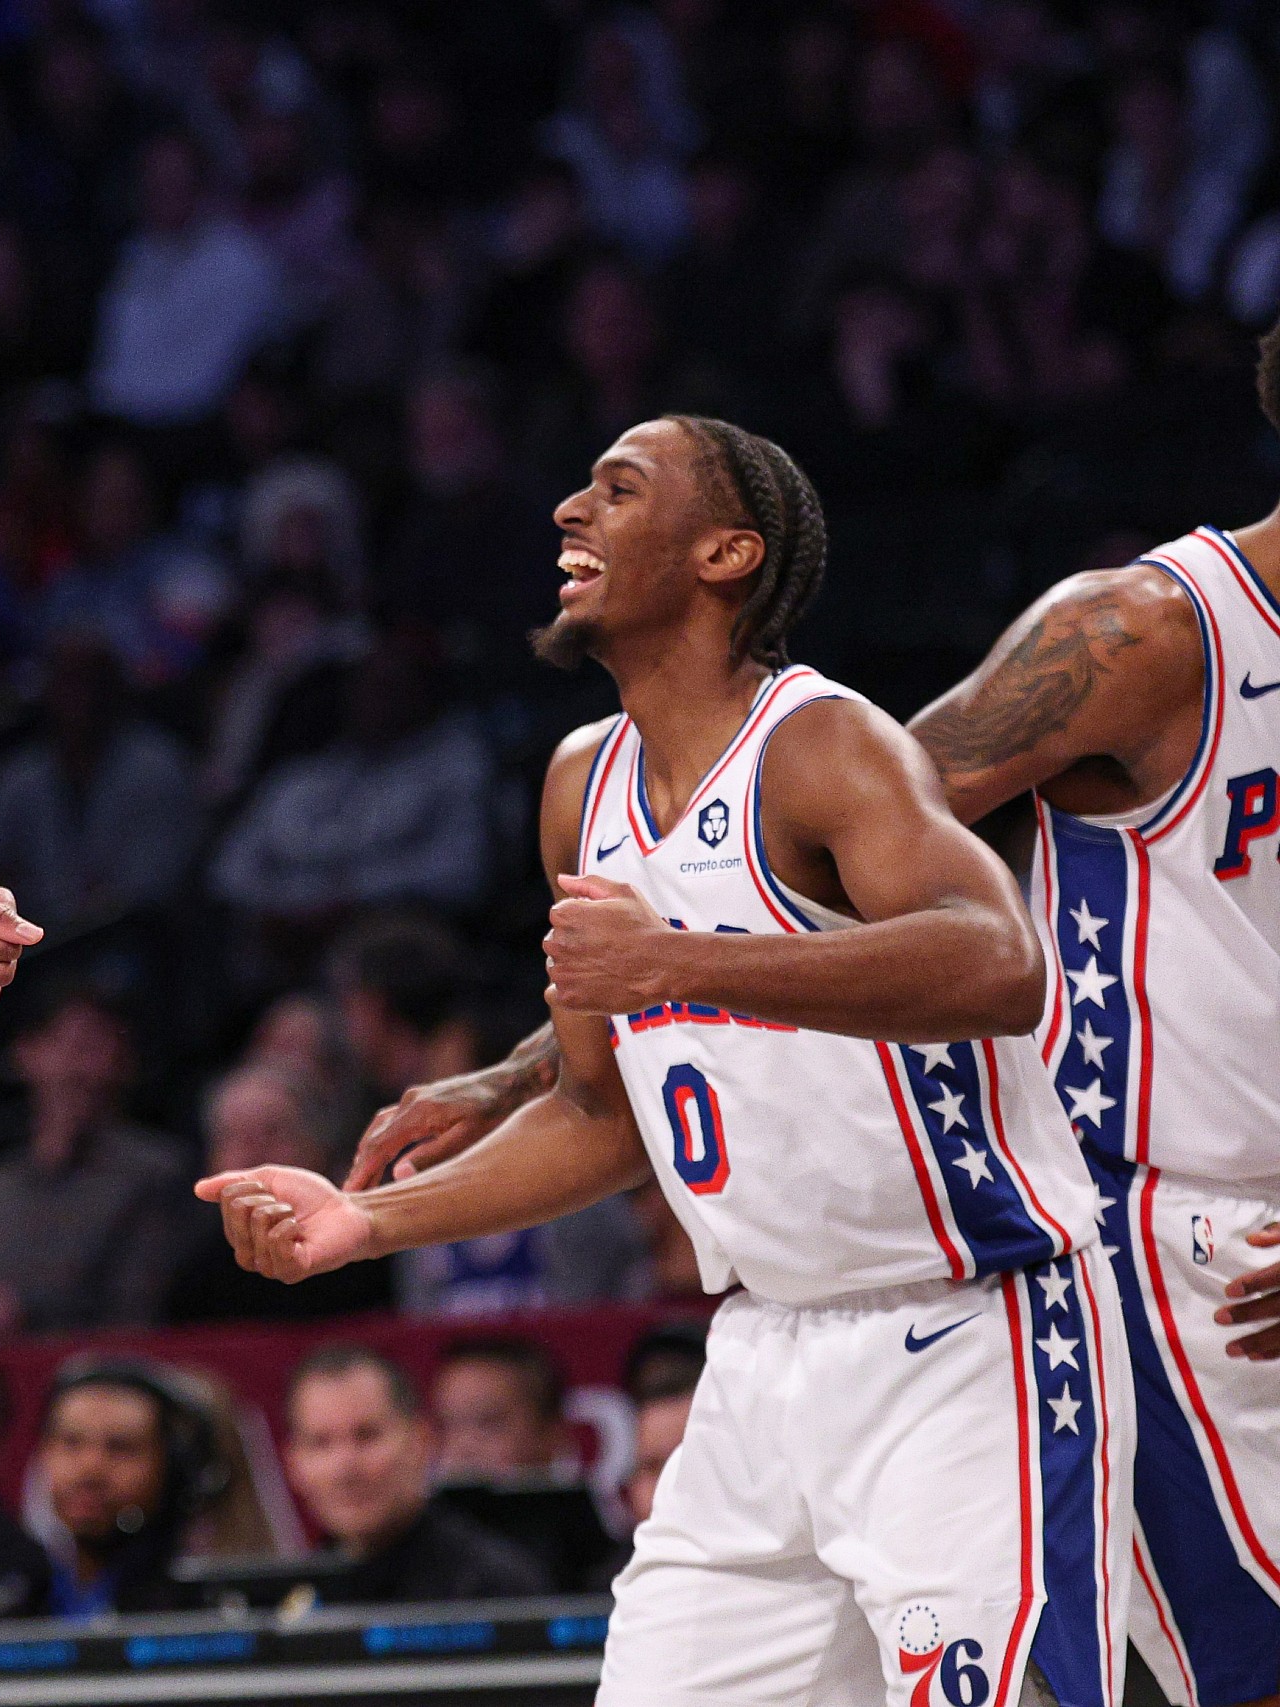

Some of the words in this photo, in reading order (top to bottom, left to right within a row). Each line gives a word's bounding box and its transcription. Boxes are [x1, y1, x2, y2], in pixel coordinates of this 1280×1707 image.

[680, 857, 742, 874] crypto.com
[1213, 767, 1280, 882] P
[662, 1063, 731, 1196] 0
[898, 1638, 989, 1707] 76
